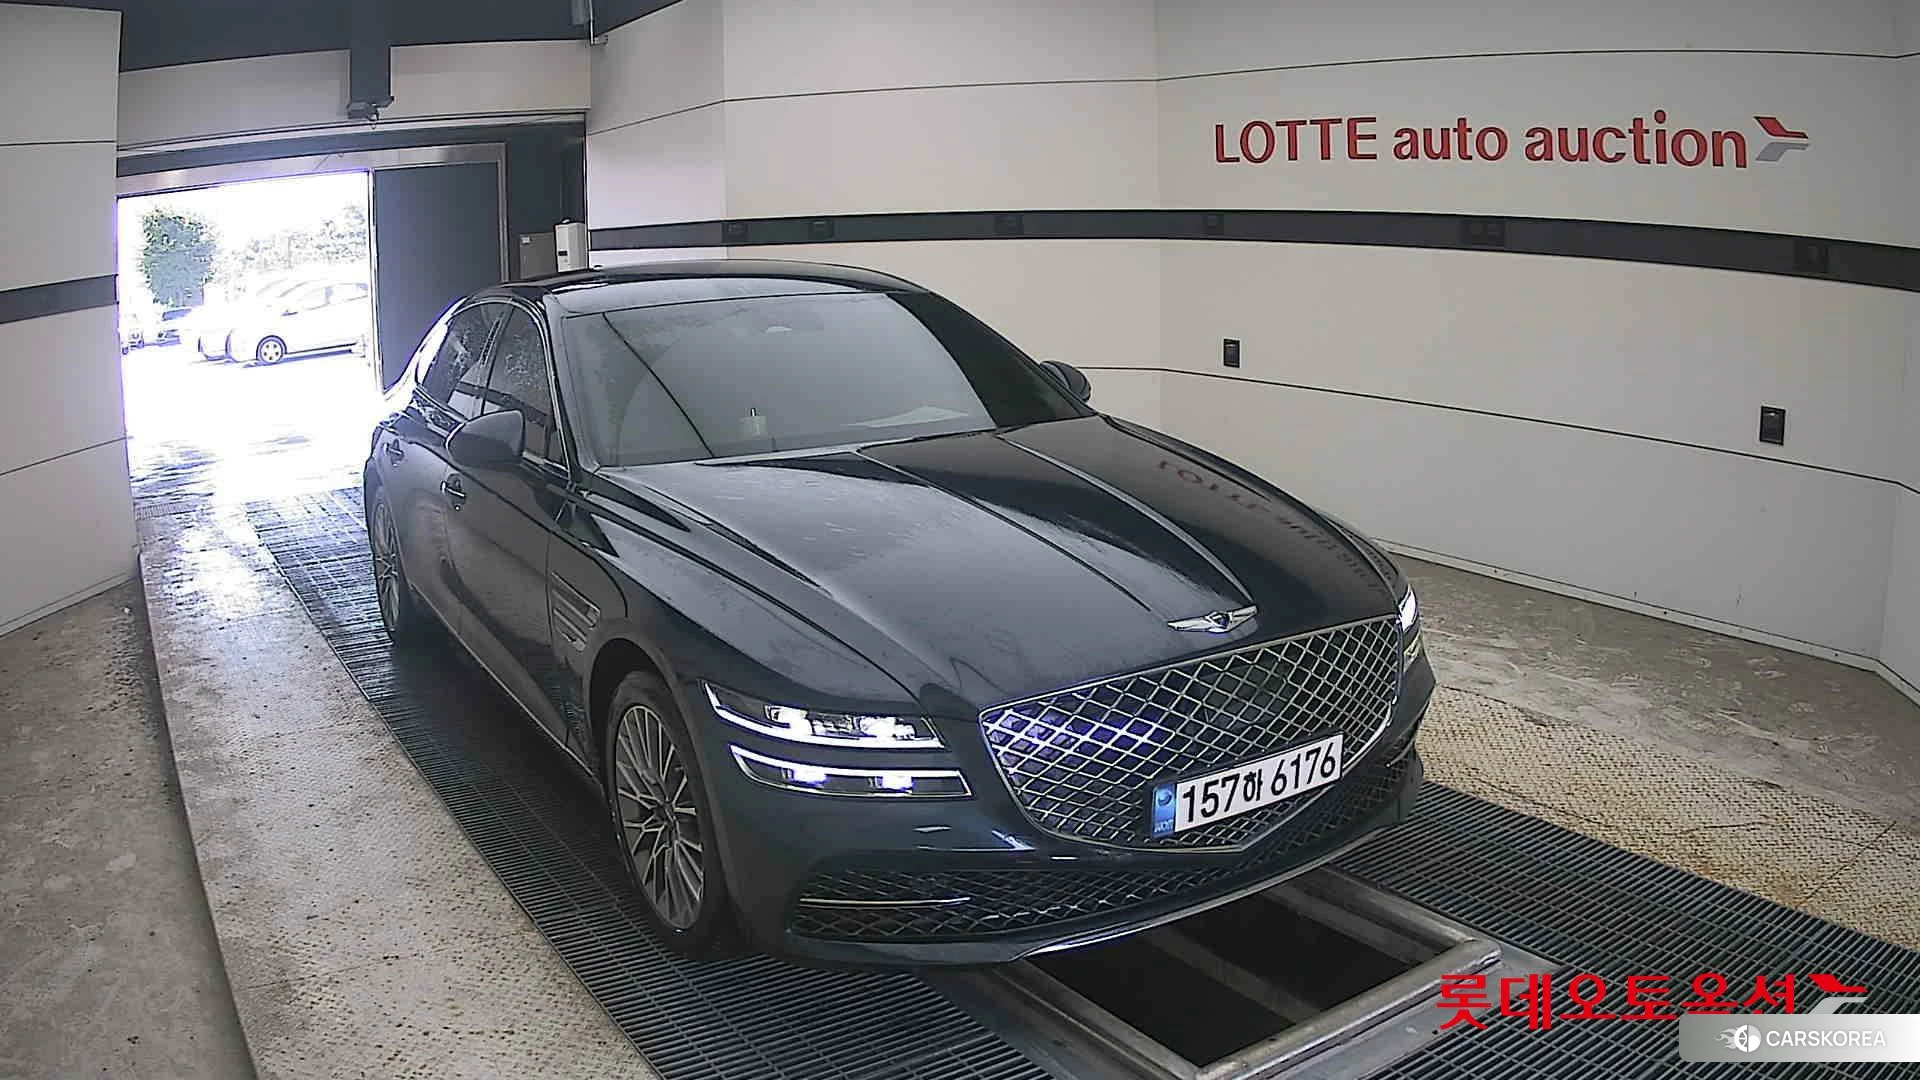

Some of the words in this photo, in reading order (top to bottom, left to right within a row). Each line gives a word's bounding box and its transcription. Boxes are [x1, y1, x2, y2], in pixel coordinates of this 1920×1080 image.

[1214, 117, 1377, 164] LOTTE
[1393, 117, 1508, 161] auto
[1524, 109, 1748, 169] auction
[1182, 768, 1263, 823] 157하
[1270, 741, 1336, 796] 6176
